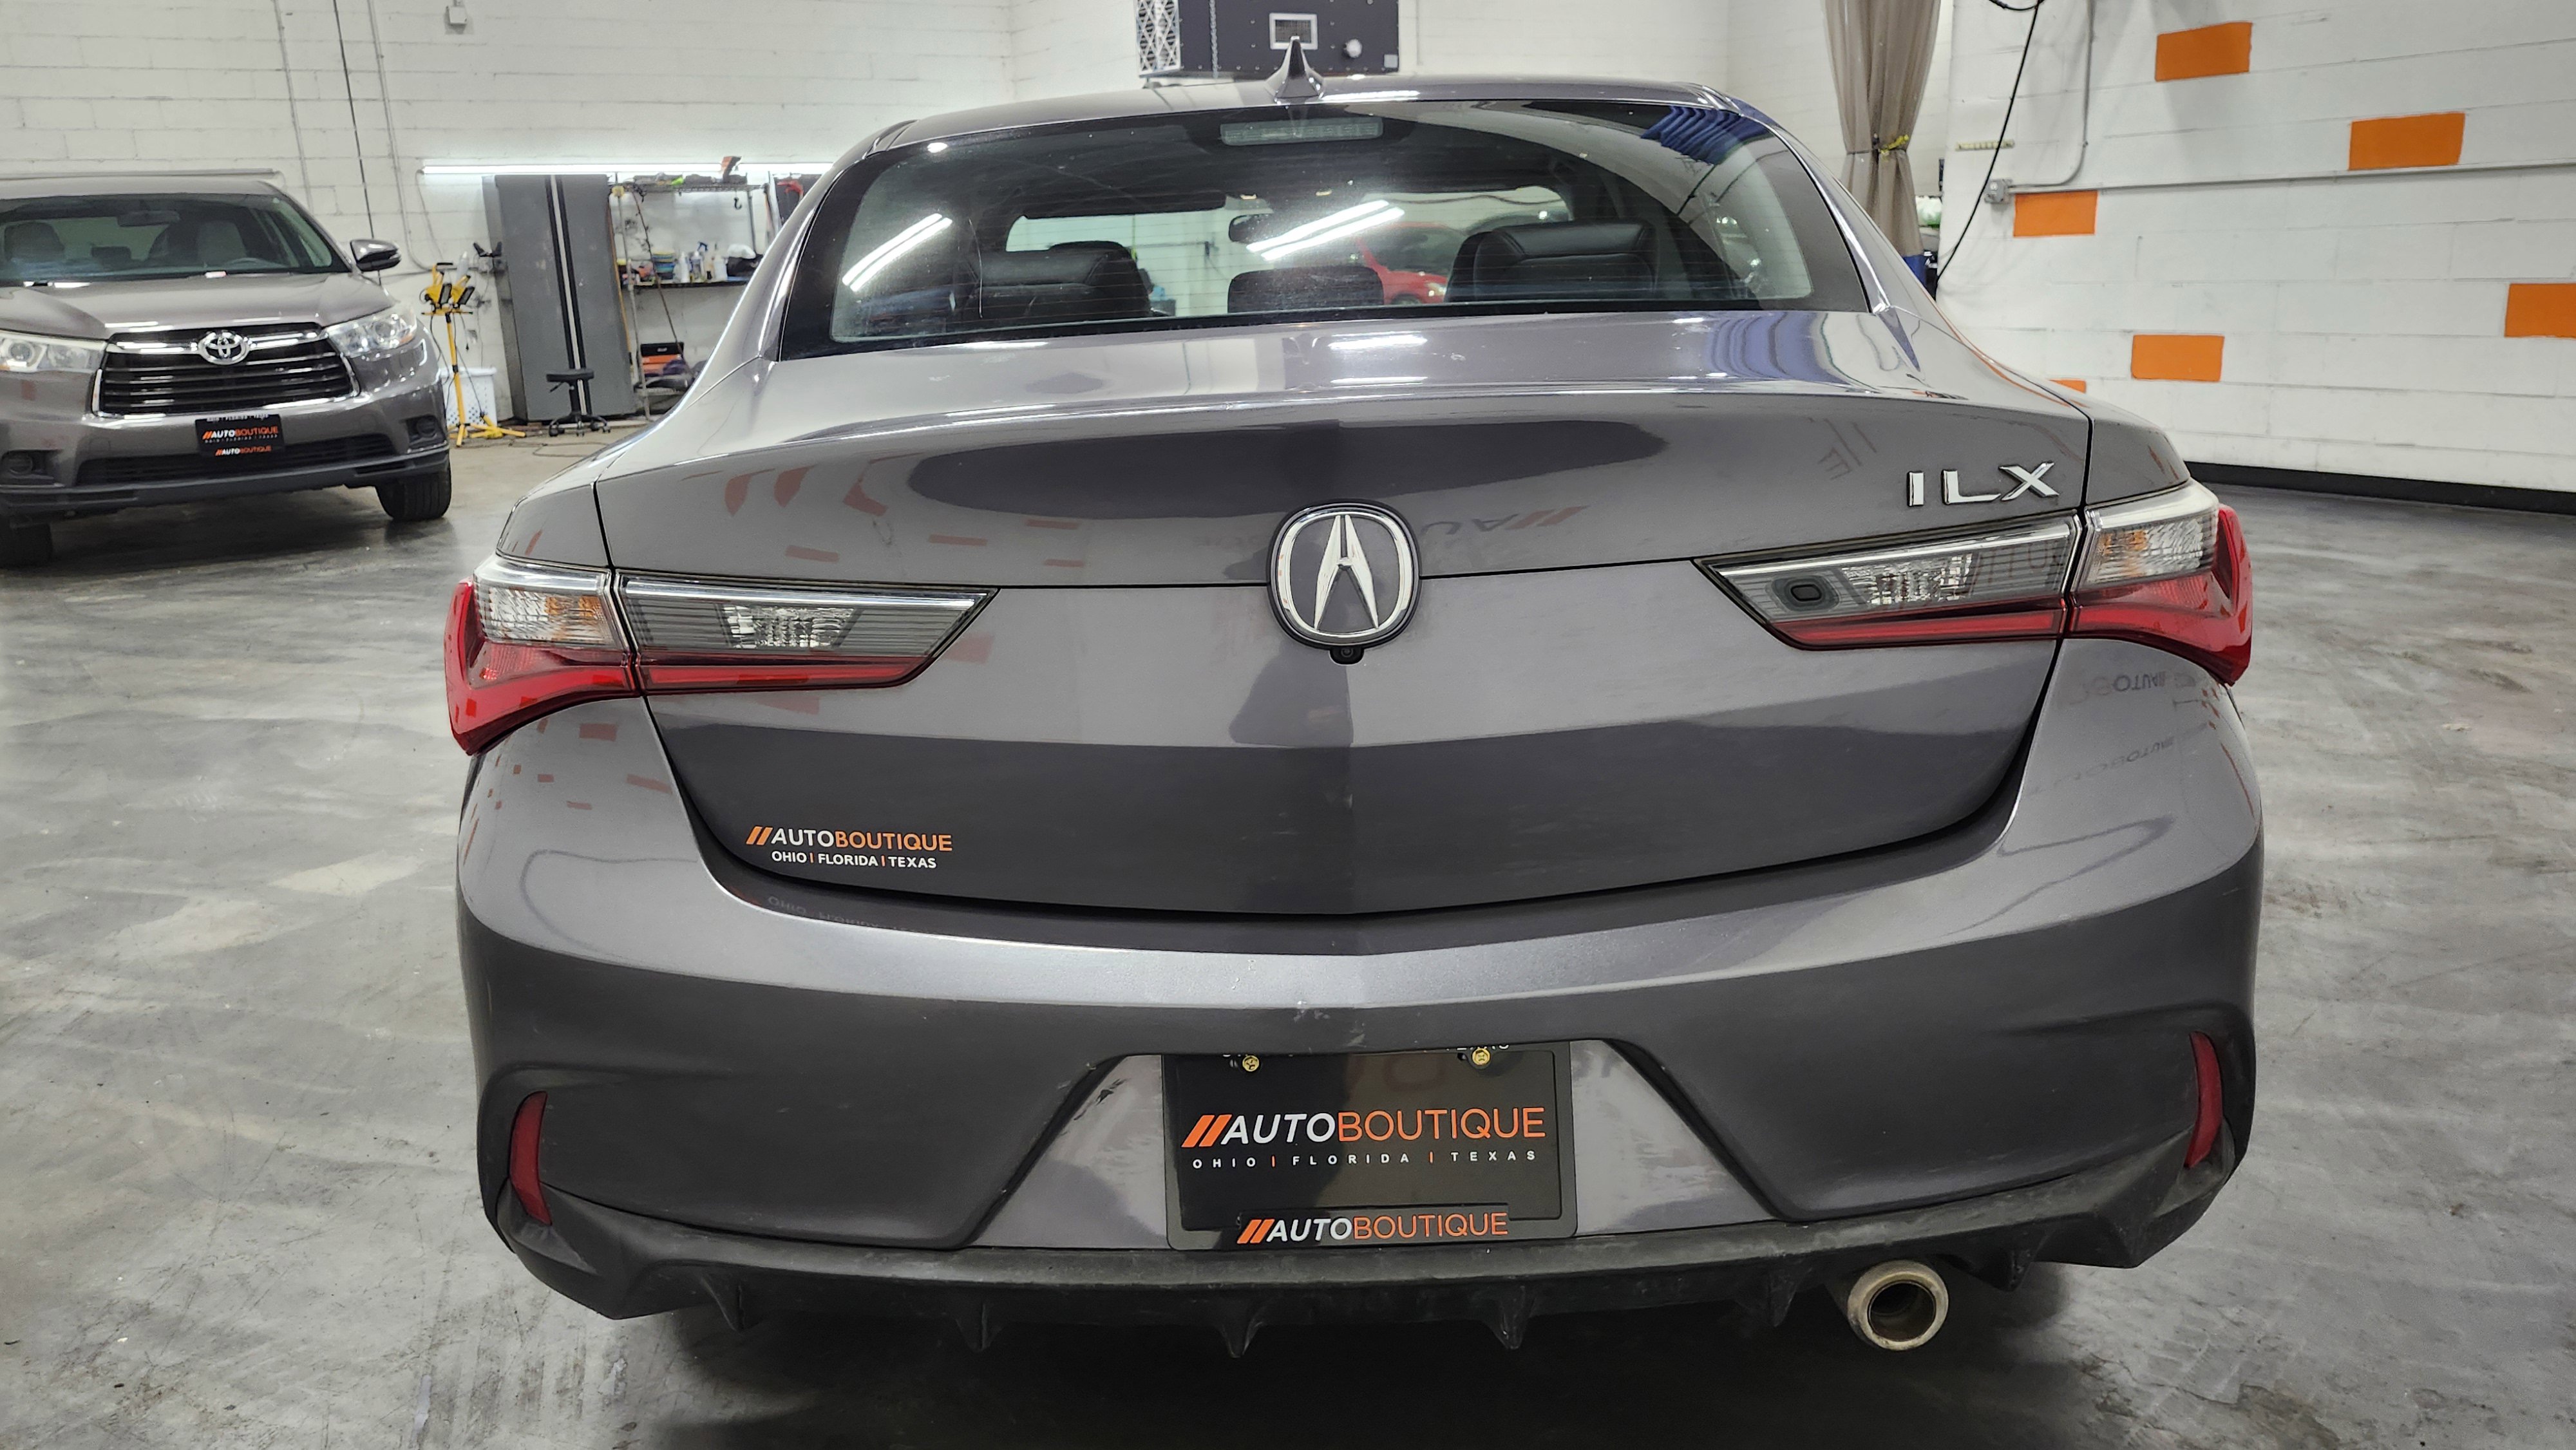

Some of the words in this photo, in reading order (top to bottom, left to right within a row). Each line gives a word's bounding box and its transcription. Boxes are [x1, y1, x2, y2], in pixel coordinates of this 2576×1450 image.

[1907, 462, 2060, 507] ILX
[771, 828, 953, 851] AUTOBOUTIQUE
[772, 851, 807, 863] OHIO
[818, 853, 878, 867] FLORIDA
[888, 856, 937, 869] TEXAS
[1220, 1107, 1546, 1145] AUTOBOUTIQUE
[1193, 1157, 1256, 1169] OHIO
[1293, 1151, 1409, 1167] FLORIDA
[1450, 1150, 1535, 1162] TEXAS
[1266, 1212, 1508, 1243] AUTOBOUTIQUE
